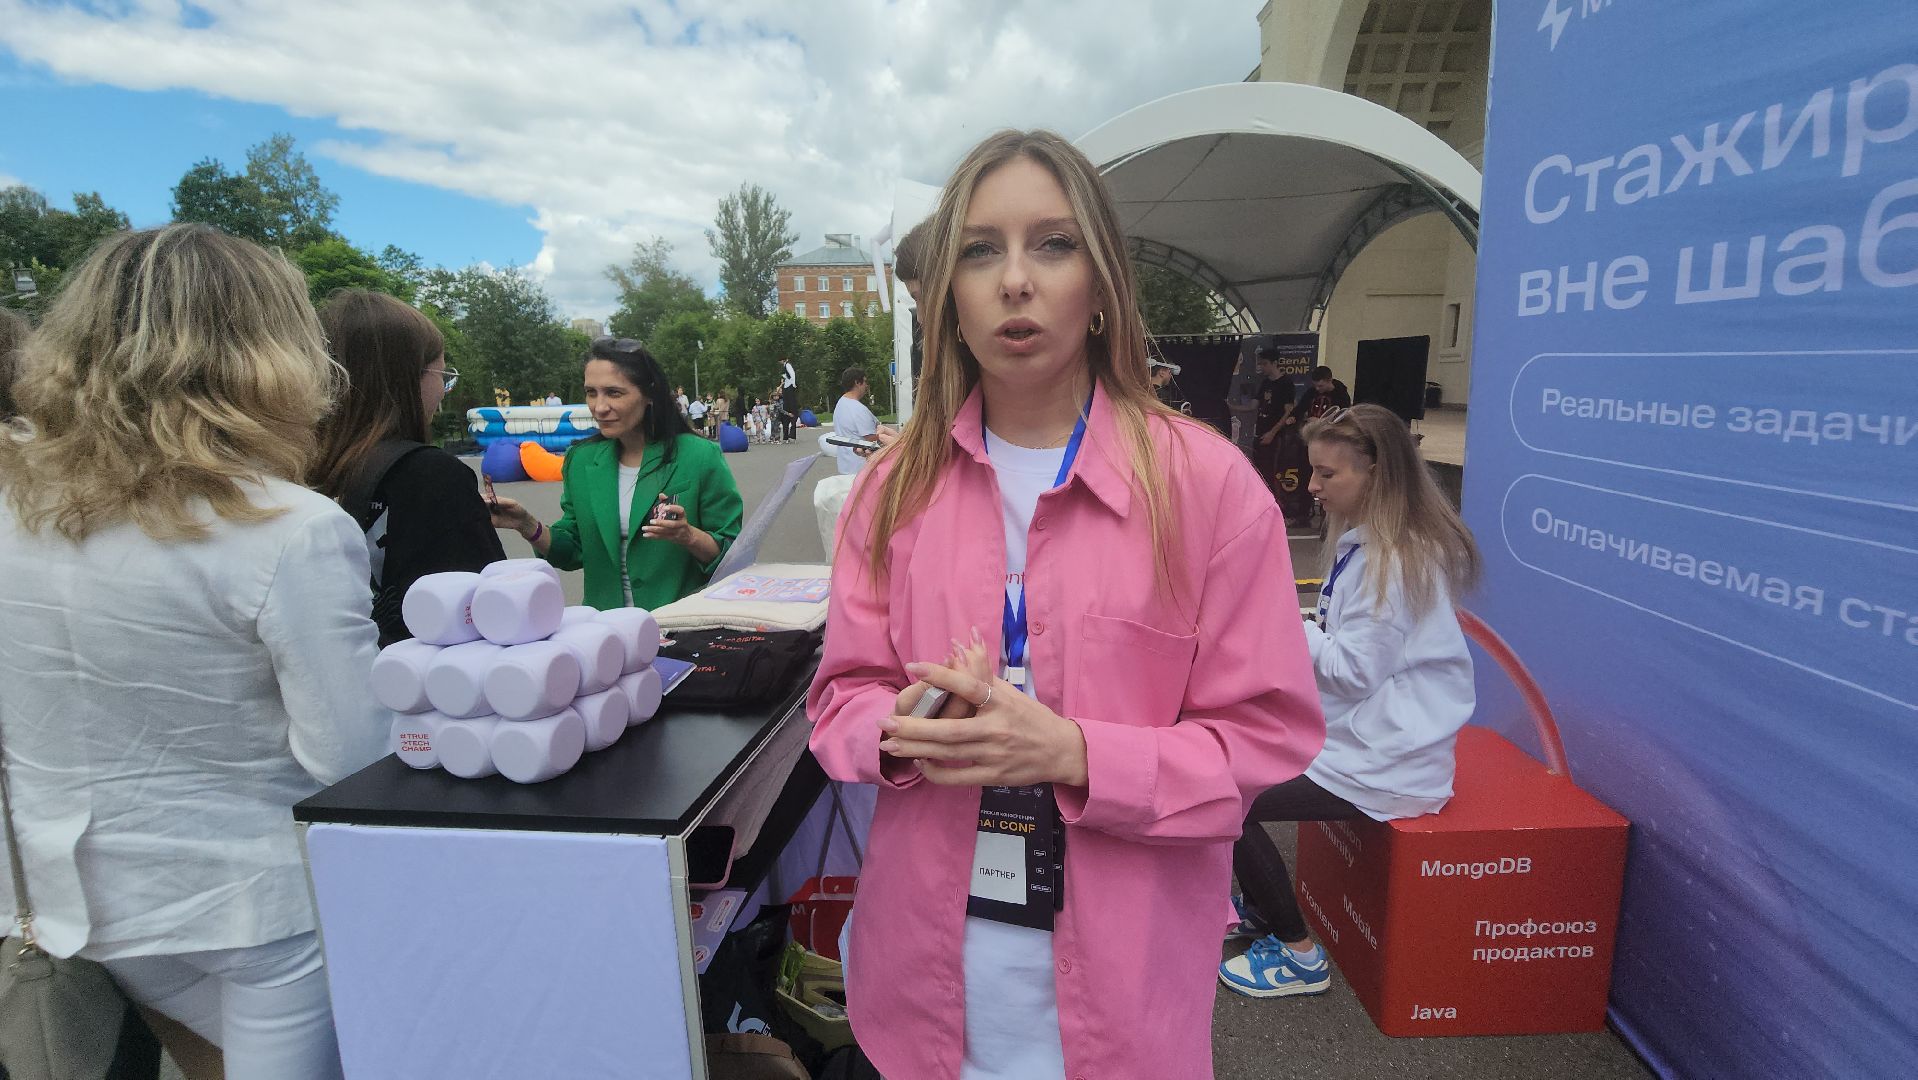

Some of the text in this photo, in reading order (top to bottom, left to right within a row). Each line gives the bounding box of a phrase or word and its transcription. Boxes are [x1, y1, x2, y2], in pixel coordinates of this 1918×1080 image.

[1518, 254, 1650, 317] вне
[1541, 387, 1717, 430] Реальные
[1531, 507, 1826, 617] Оплачиваемая
[999, 820, 1036, 834] CONF
[979, 867, 1016, 880] ПАРТНЕР
[1420, 857, 1533, 880] MongoDB
[1301, 880, 1339, 944] Frontend
[1343, 893, 1378, 950] Mobile
[1474, 918, 1598, 940] Профсоюз
[1472, 945, 1595, 963] продактов
[1410, 1004, 1458, 1021] Java
